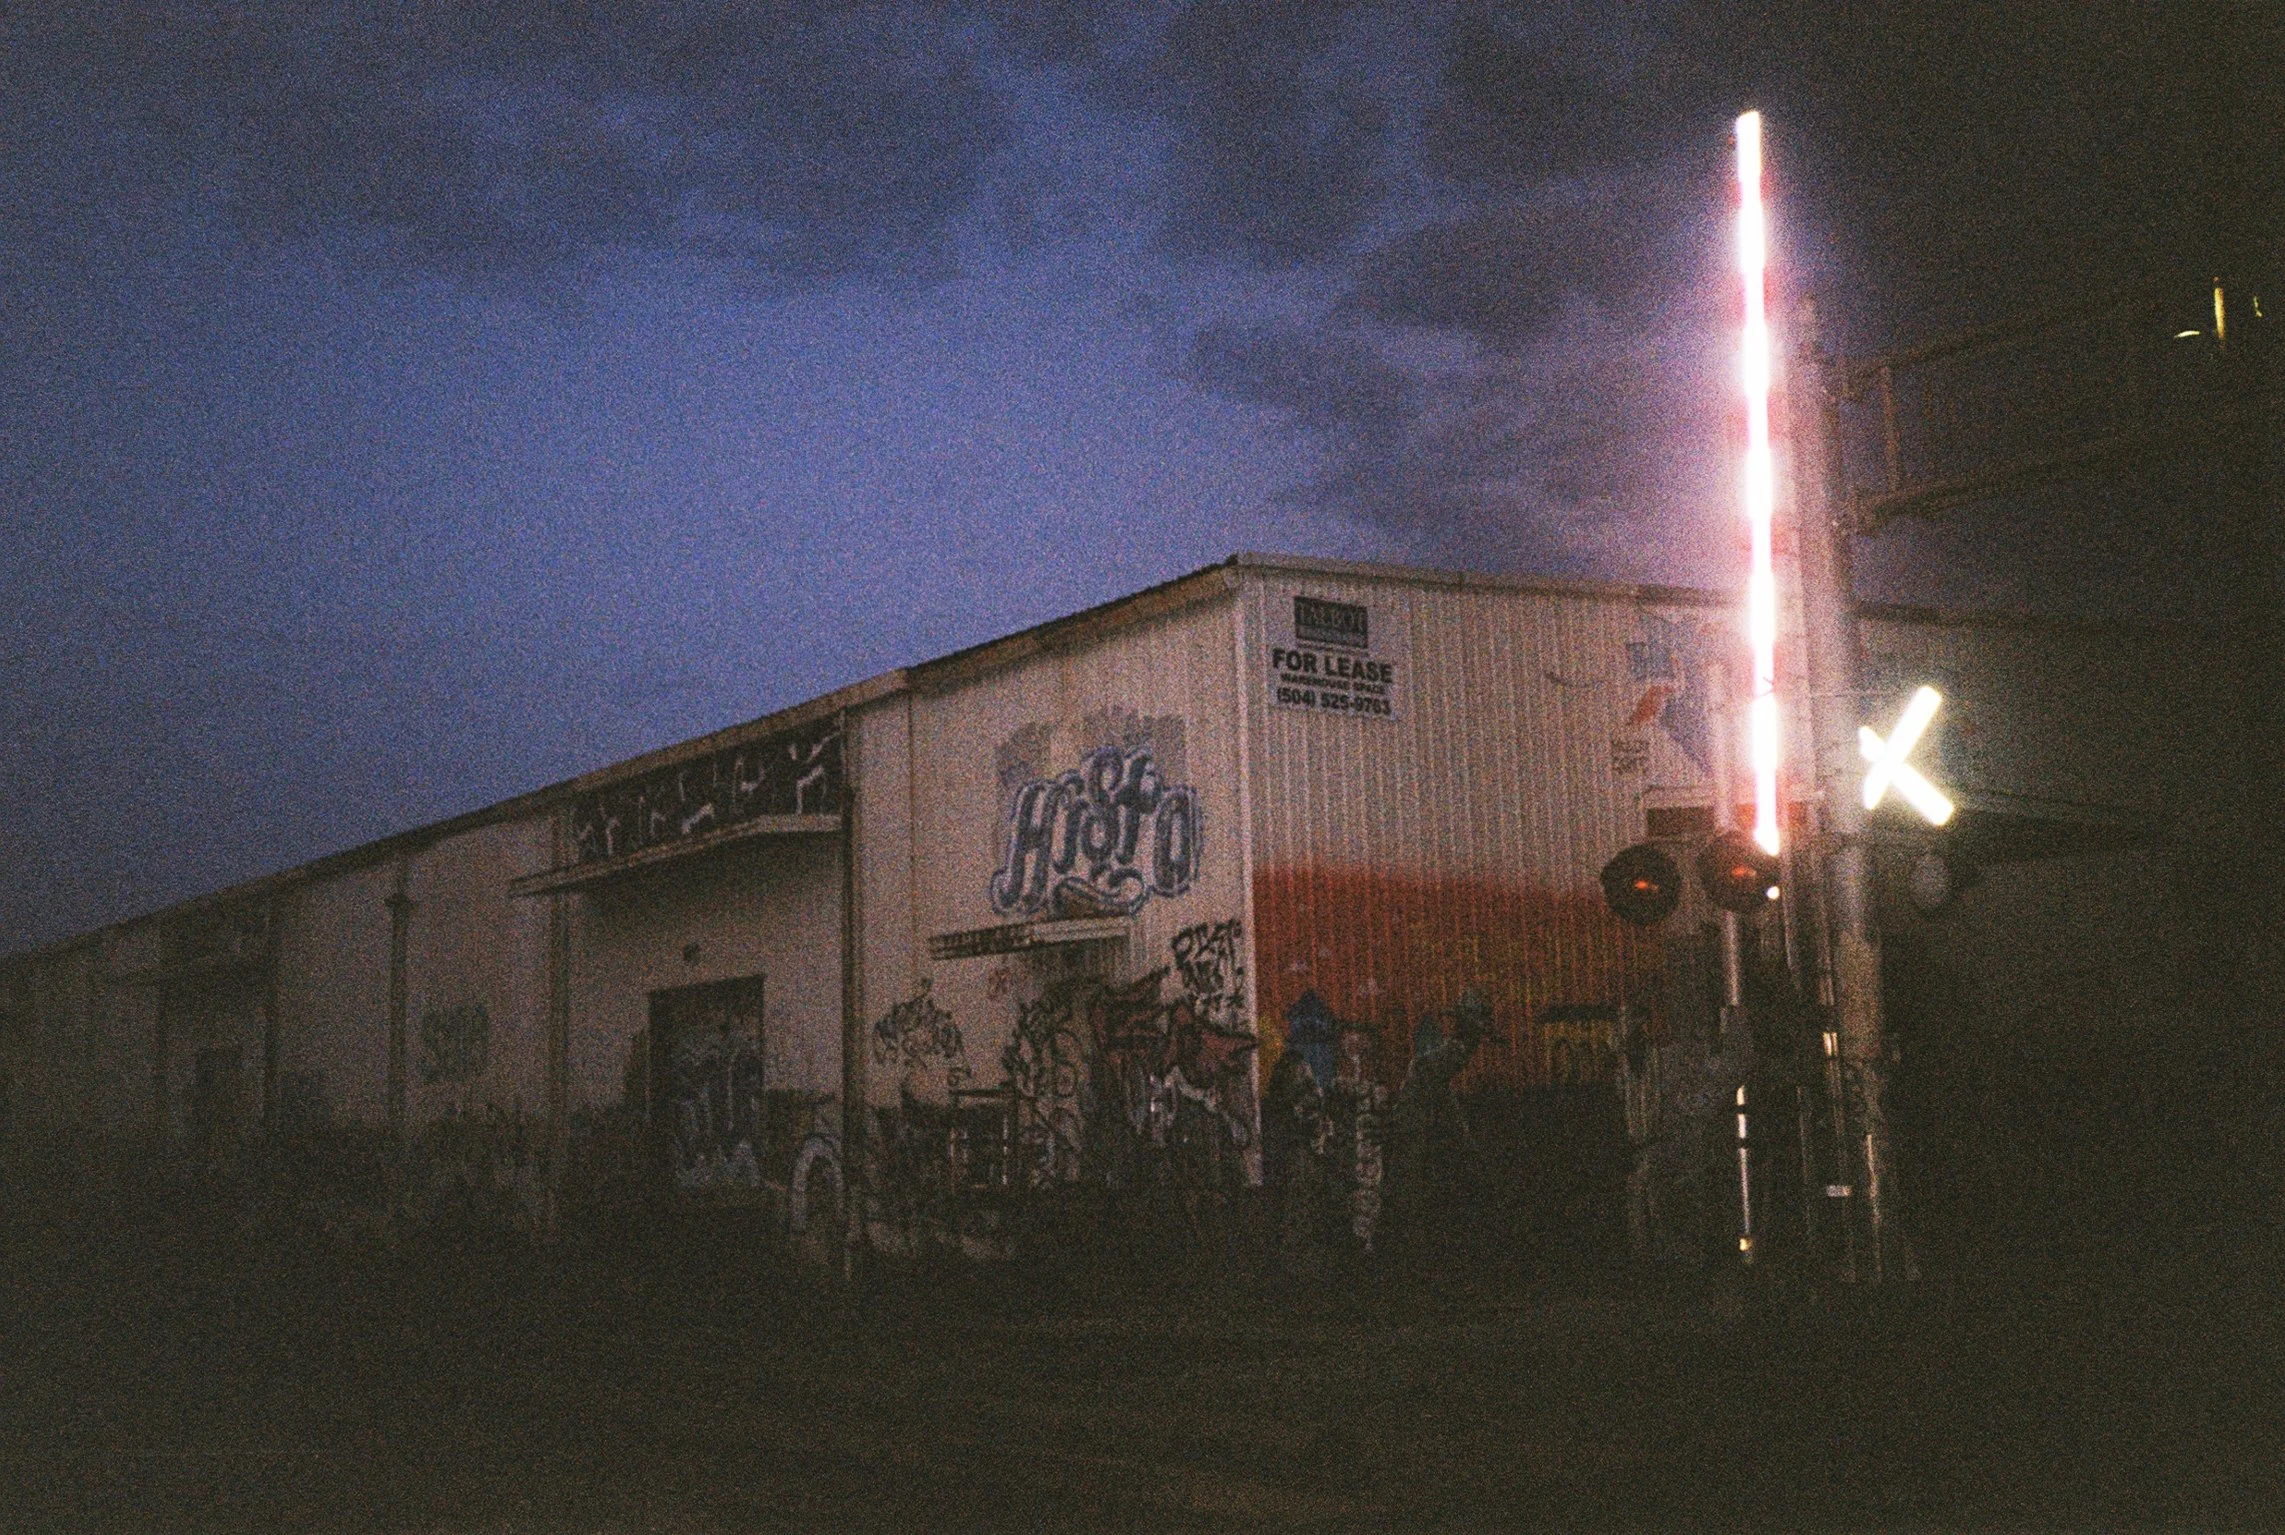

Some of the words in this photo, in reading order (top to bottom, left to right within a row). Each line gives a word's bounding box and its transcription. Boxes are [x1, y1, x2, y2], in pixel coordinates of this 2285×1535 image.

[1273, 649, 1317, 673] FOR
[1325, 656, 1392, 683] LEASE
[1277, 687, 1316, 708] (504)
